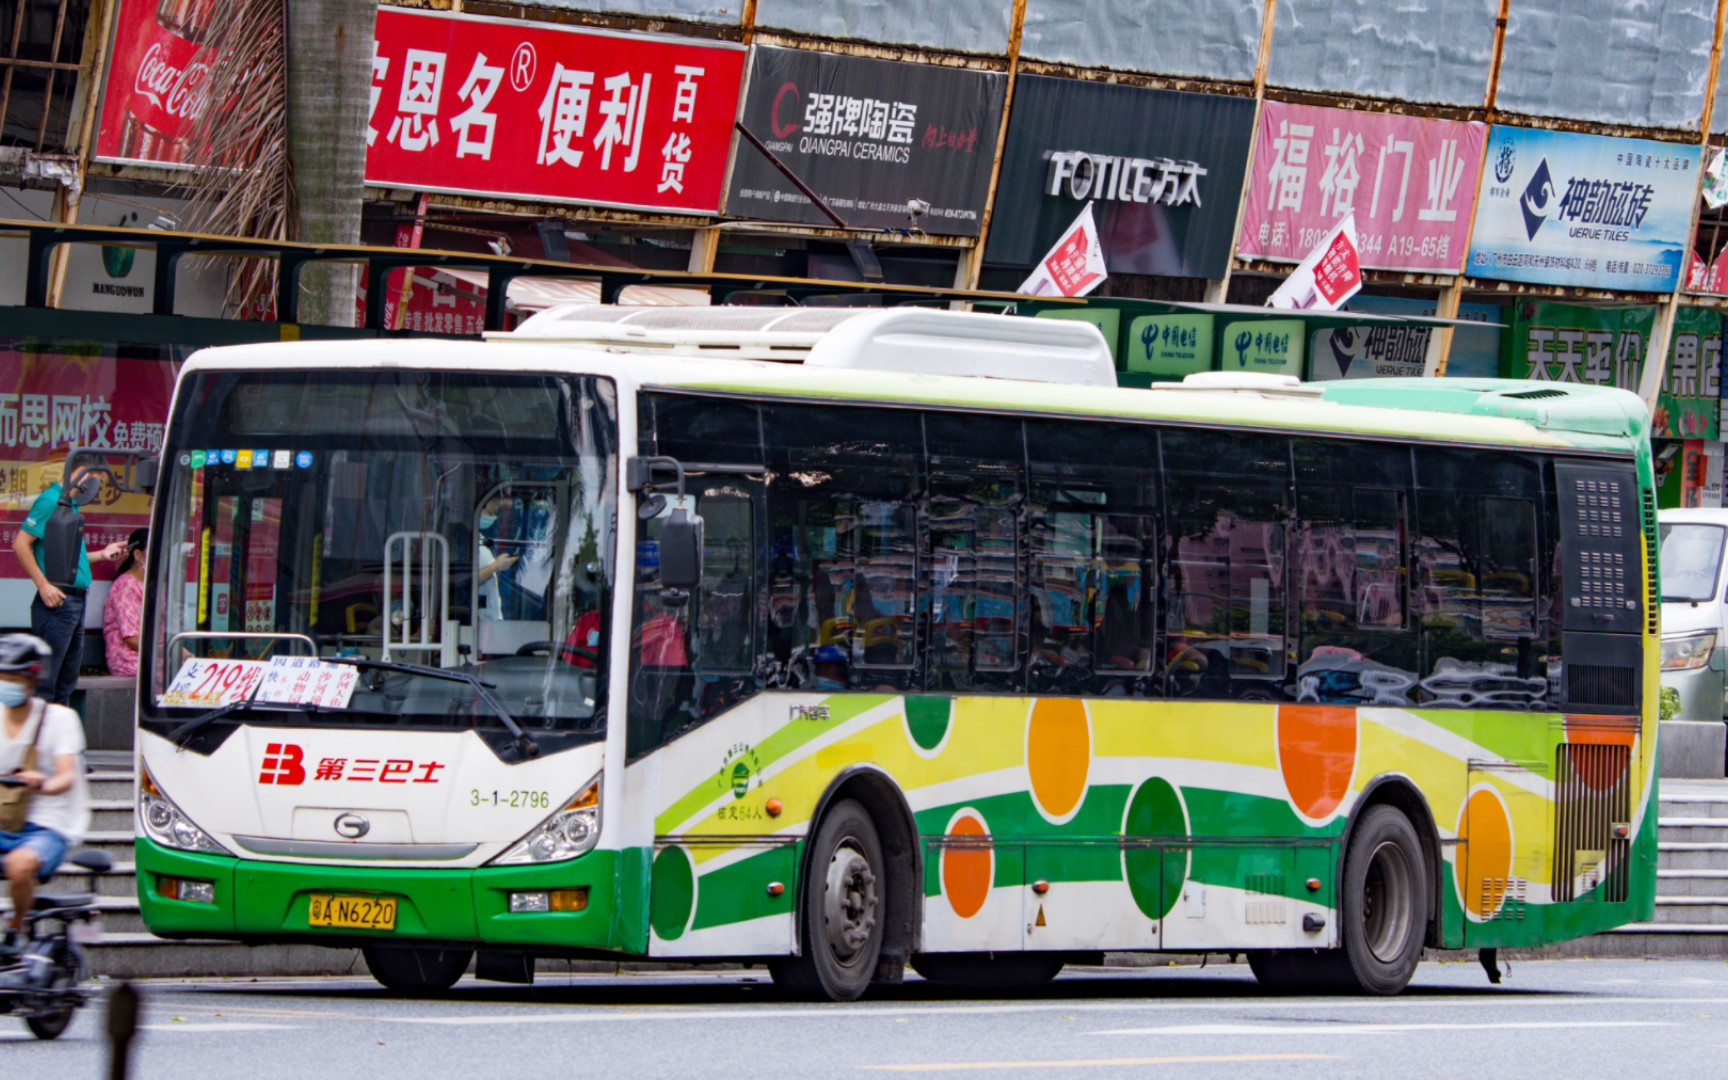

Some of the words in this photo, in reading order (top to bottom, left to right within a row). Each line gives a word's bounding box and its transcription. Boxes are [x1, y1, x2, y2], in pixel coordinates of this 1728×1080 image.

[536, 61, 652, 173] 便利
[657, 65, 705, 195] 百货
[802, 92, 917, 144] 强牌陶瓷
[800, 136, 851, 157] QIANGPAI
[853, 142, 910, 164] CERAMICS
[1268, 119, 1465, 222] 福裕门业
[1046, 151, 1156, 203] FOTILE
[1364, 326, 1432, 364] 神韵磁
[1527, 328, 1723, 398] 天天平价果店
[1406, 366, 1424, 377] TILE
[314, 757, 446, 784] 第三巴士
[470, 789, 550, 809] 3-1-2796
